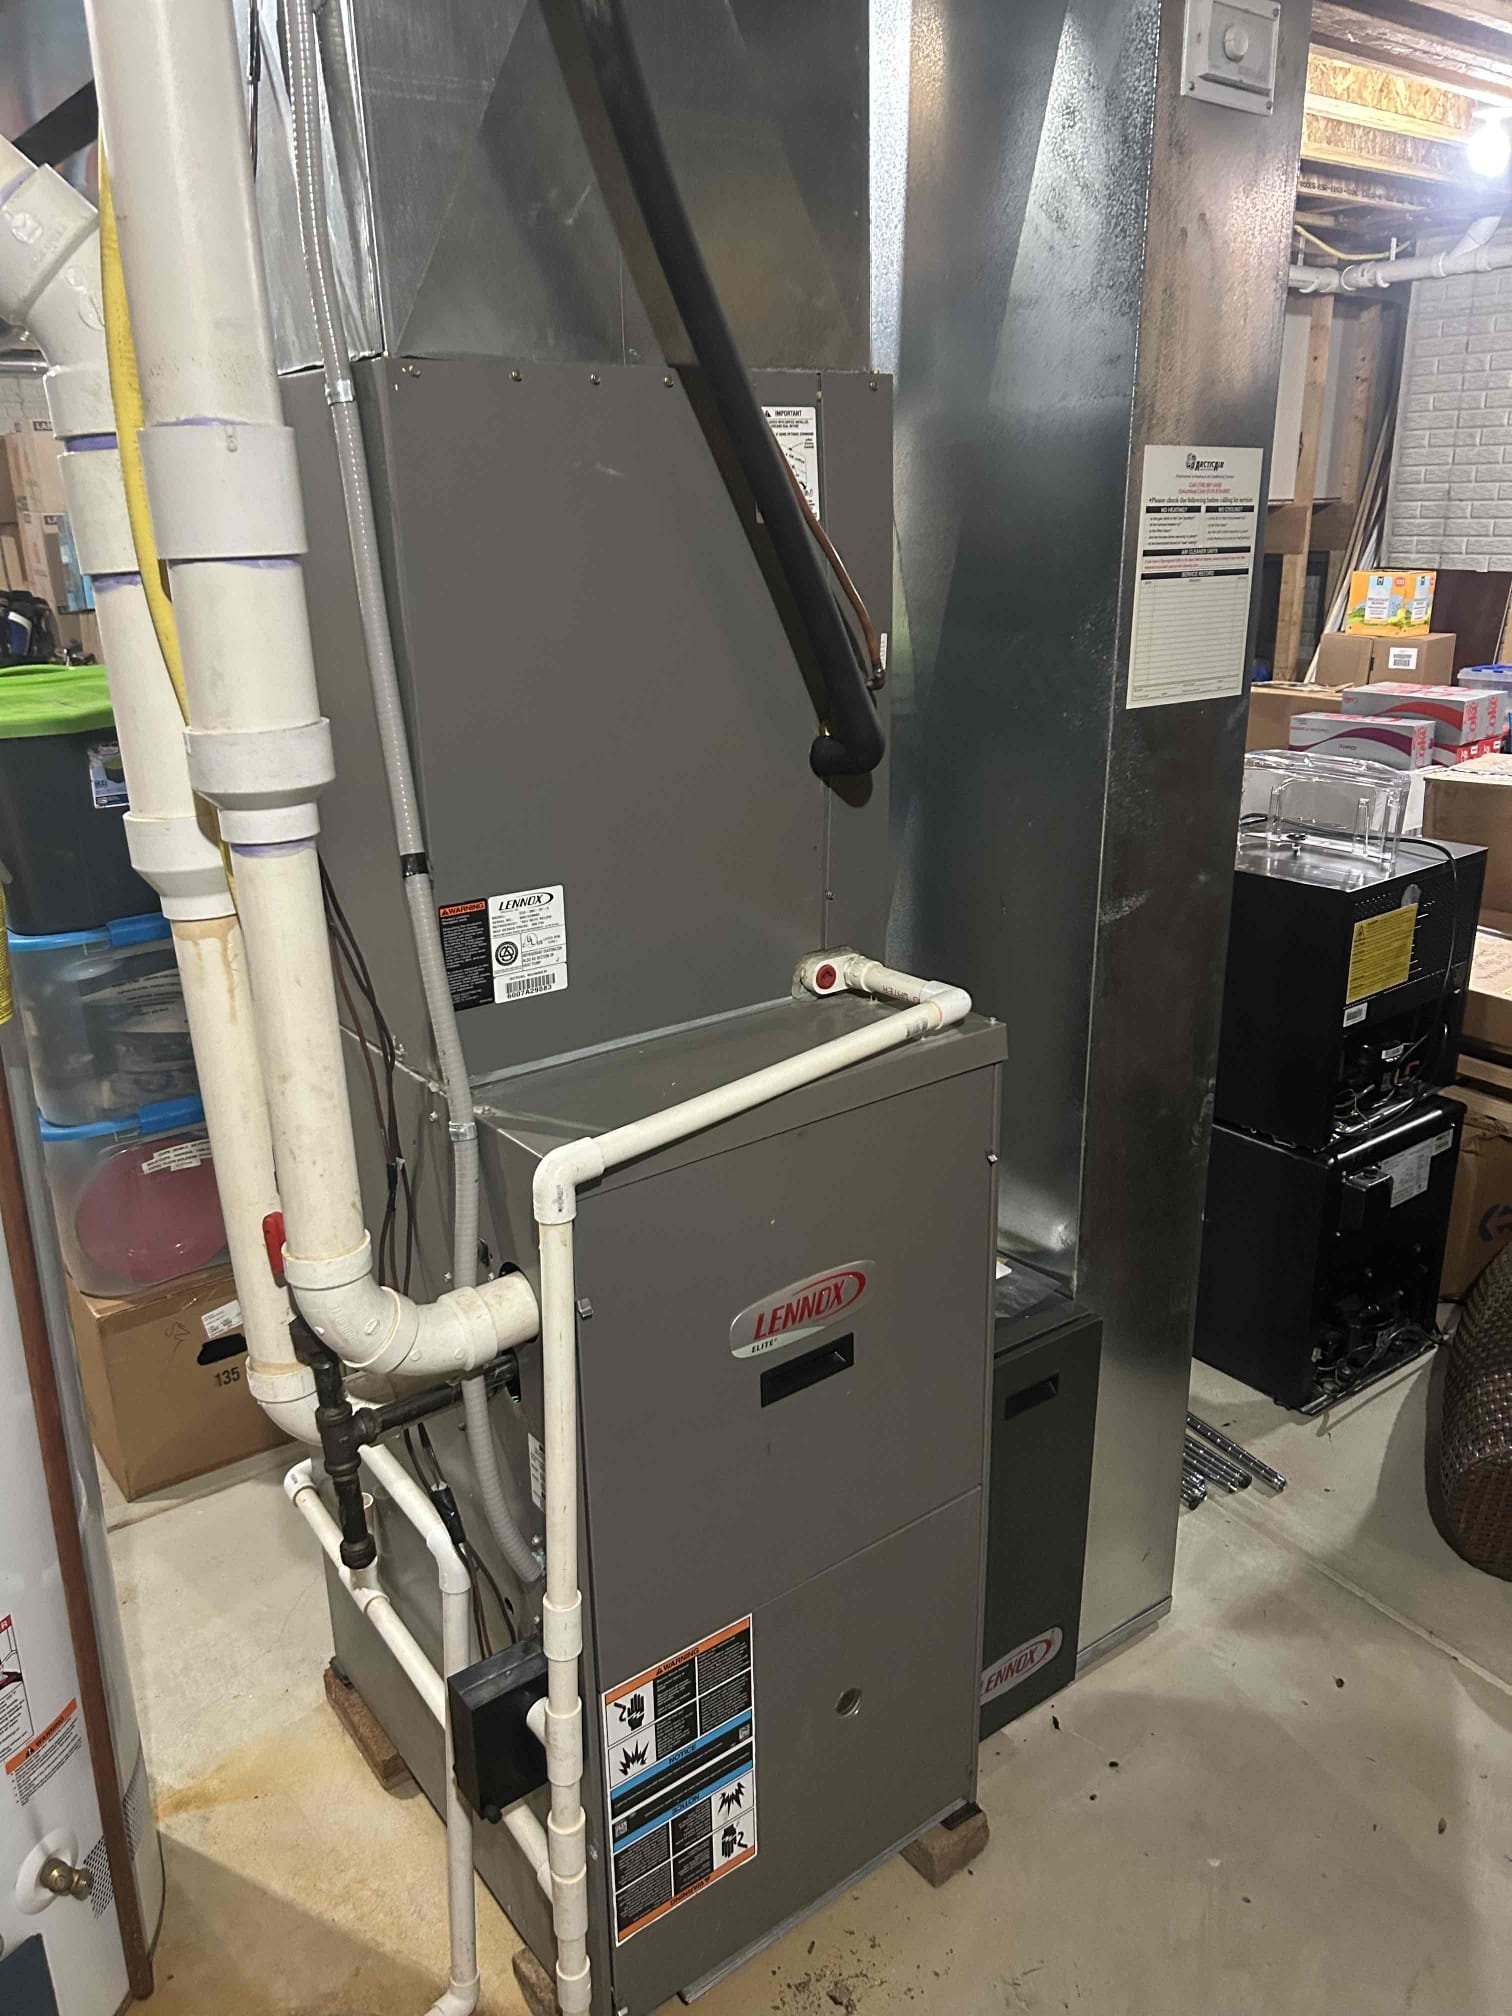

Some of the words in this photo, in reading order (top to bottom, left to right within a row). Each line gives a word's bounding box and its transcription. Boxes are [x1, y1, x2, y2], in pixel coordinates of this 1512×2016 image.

[448, 902, 484, 915] WARNING
[498, 895, 544, 911] LENNOX
[753, 1280, 845, 1340] LENNOX
[214, 1367, 240, 1387] 135
[663, 1647, 700, 1670] WARNING
[668, 1744, 696, 1764] NOTICE
